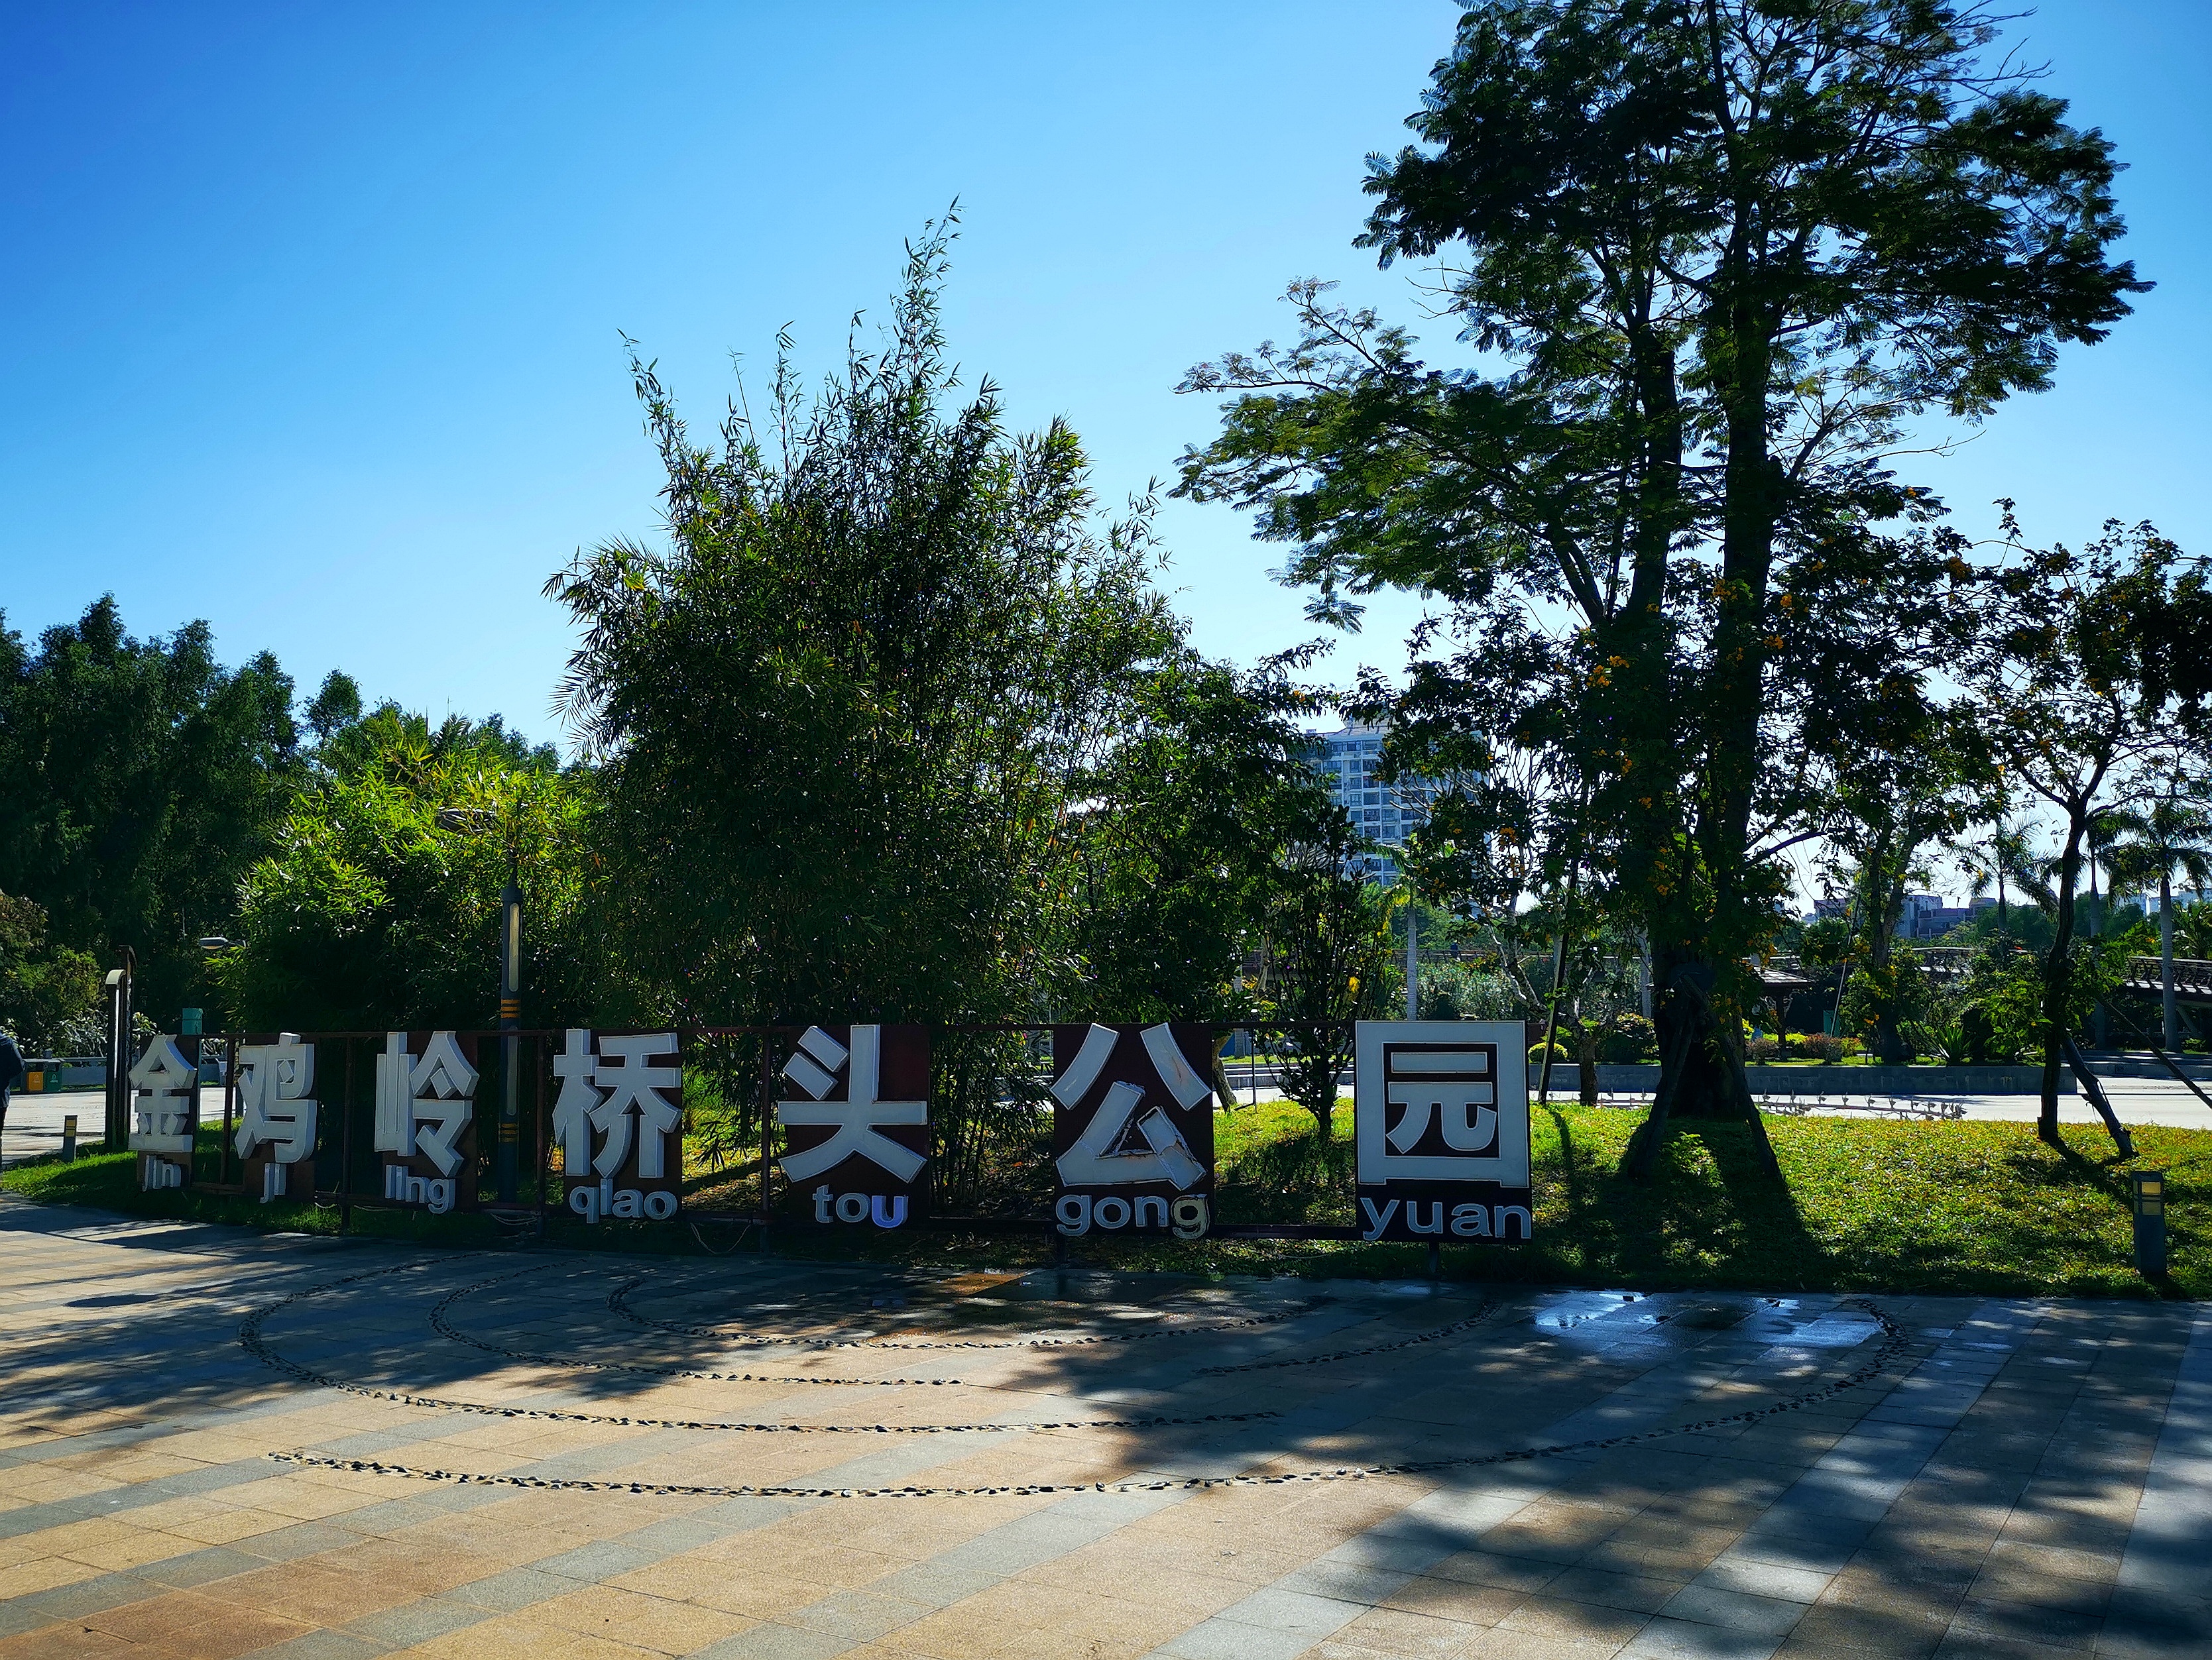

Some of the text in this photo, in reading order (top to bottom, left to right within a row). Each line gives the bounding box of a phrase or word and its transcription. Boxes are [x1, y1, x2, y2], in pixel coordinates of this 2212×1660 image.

[129, 1020, 1530, 1188] 金鸡岭桥头公园
[385, 1164, 455, 1214] ling
[569, 1178, 677, 1224] qiao
[813, 1184, 909, 1228] tou
[1056, 1193, 1208, 1239] gong
[1360, 1197, 1531, 1241] yuan
